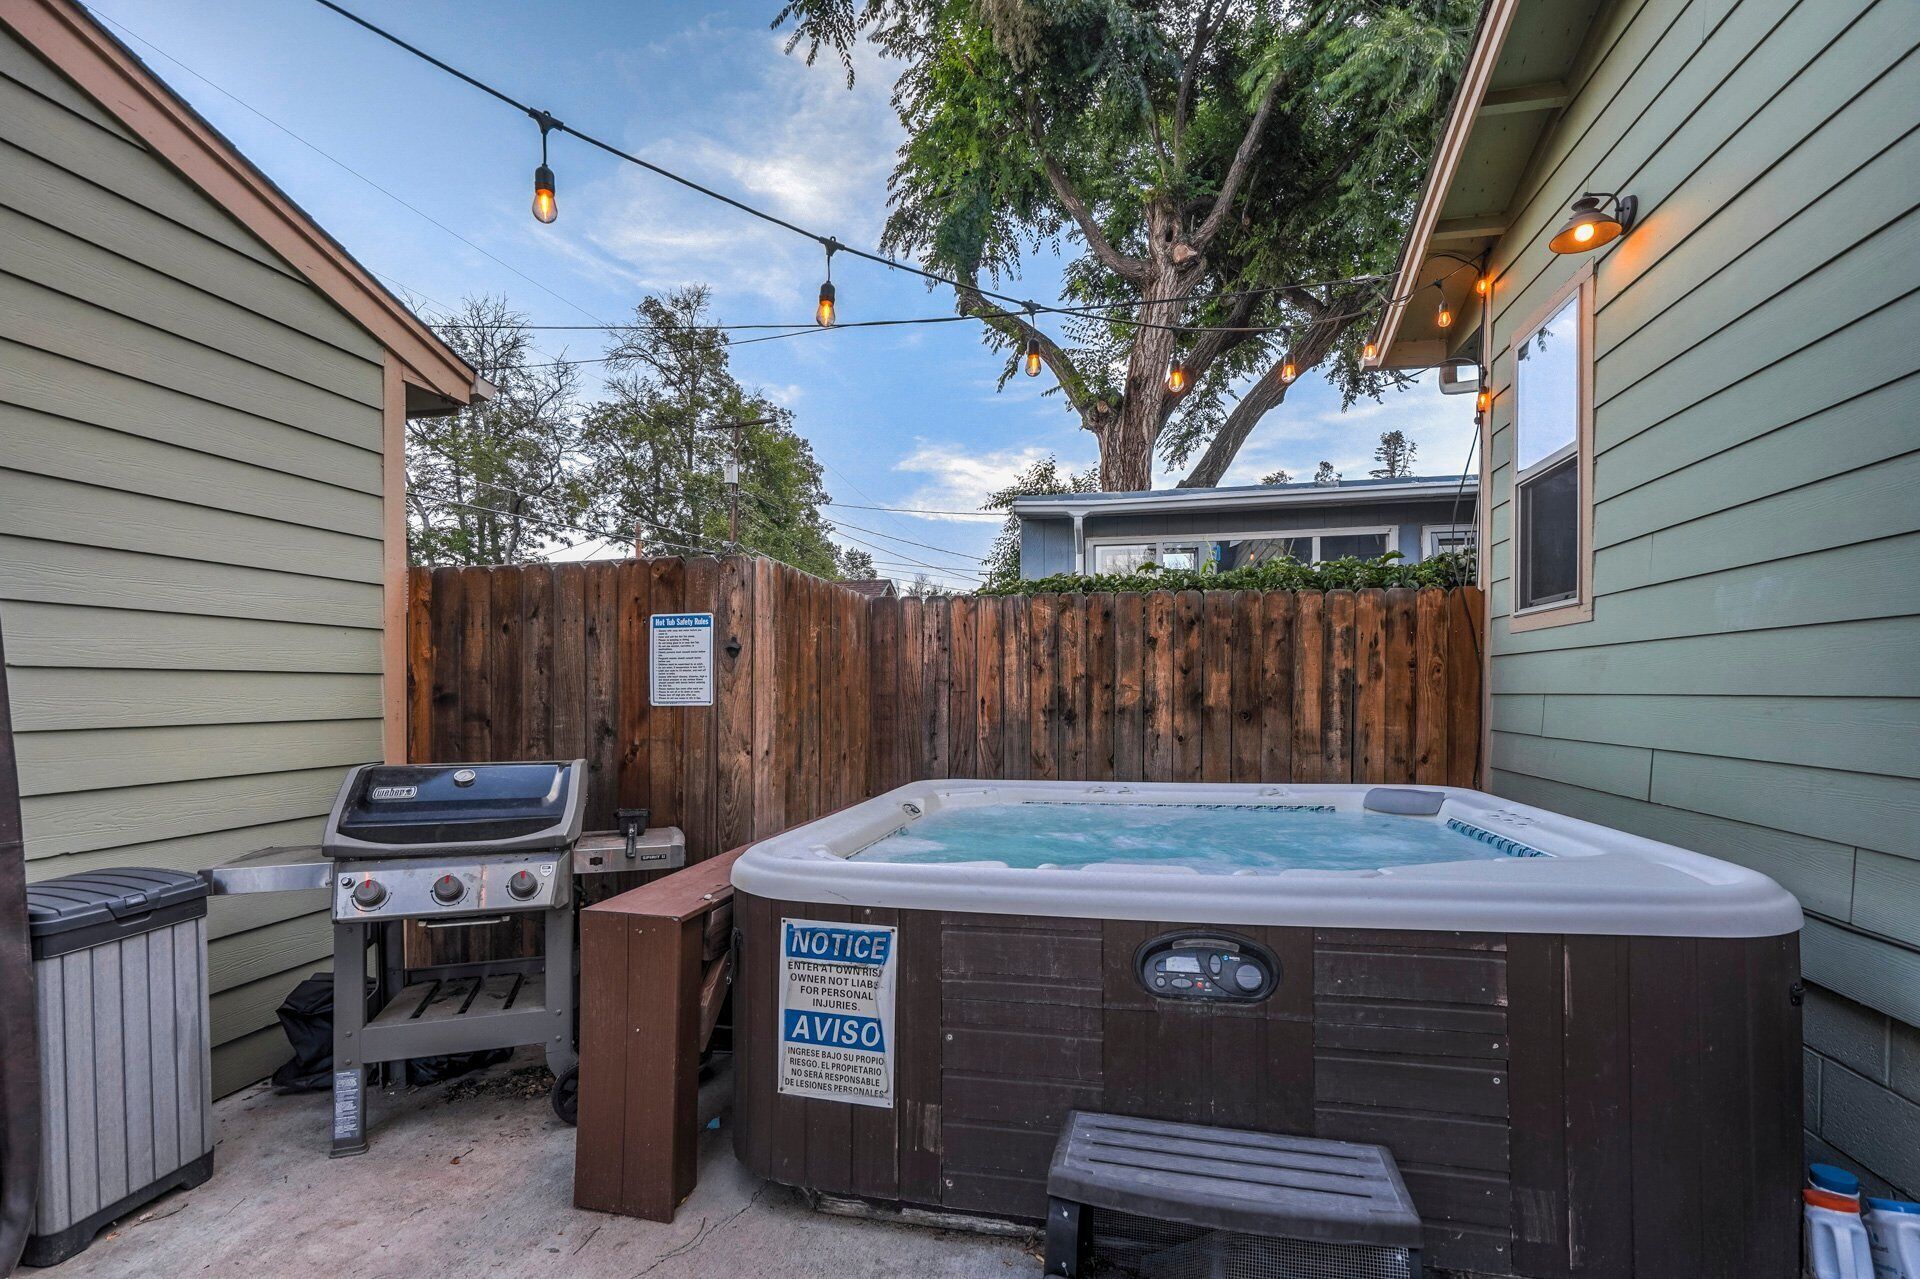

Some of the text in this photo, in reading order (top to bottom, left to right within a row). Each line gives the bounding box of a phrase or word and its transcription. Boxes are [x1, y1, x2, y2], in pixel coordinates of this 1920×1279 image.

[655, 617, 709, 627] Hot Tub Safety Rules
[791, 929, 887, 960] NOTICE
[788, 961, 819, 972] ENTER
[820, 964, 833, 973] AT
[836, 966, 860, 975] OWN
[790, 973, 827, 984] OWNER
[828, 976, 849, 986] NOT
[800, 985, 874, 1001] FOR PERSONAL
[813, 998, 860, 1011] INJURIES.
[791, 1014, 880, 1047] AVISO
[787, 1046, 885, 1066] INGRESE BAJO SU PROPIO
[789, 1057, 882, 1076] RIESGO. EL PROPIETARIO
[791, 1068, 880, 1087] NO SERÁ RESPONSABLE
[785, 1077, 884, 1098] DE LESIONES PERSONALES
